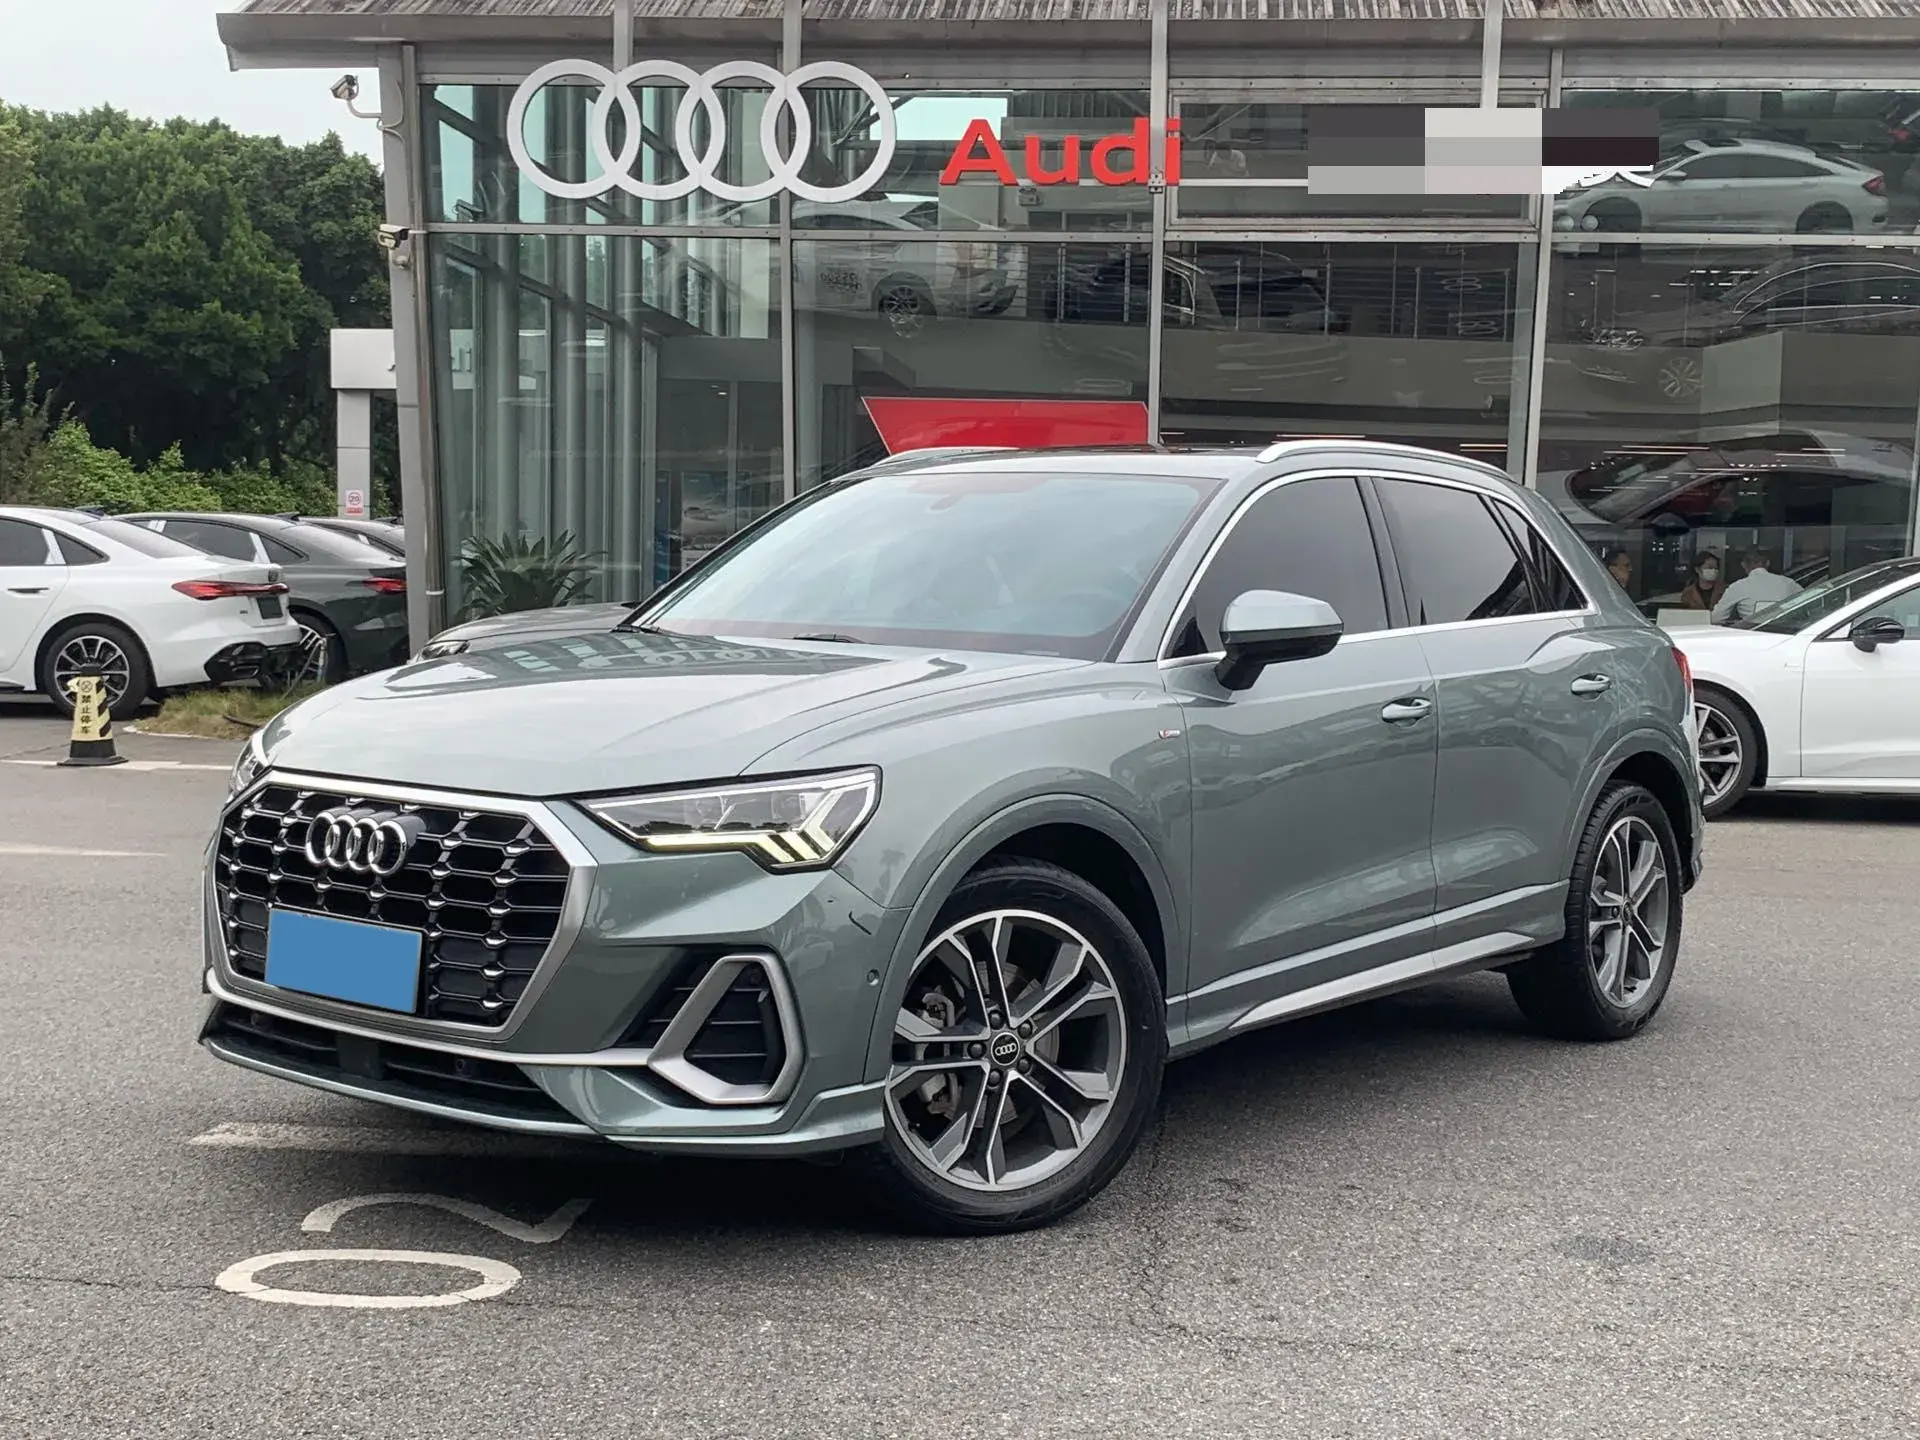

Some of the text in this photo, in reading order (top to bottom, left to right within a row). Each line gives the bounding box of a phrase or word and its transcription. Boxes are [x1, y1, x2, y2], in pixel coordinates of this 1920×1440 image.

[940, 116, 1181, 186] Audi
[80, 694, 93, 734] 禁止停车
